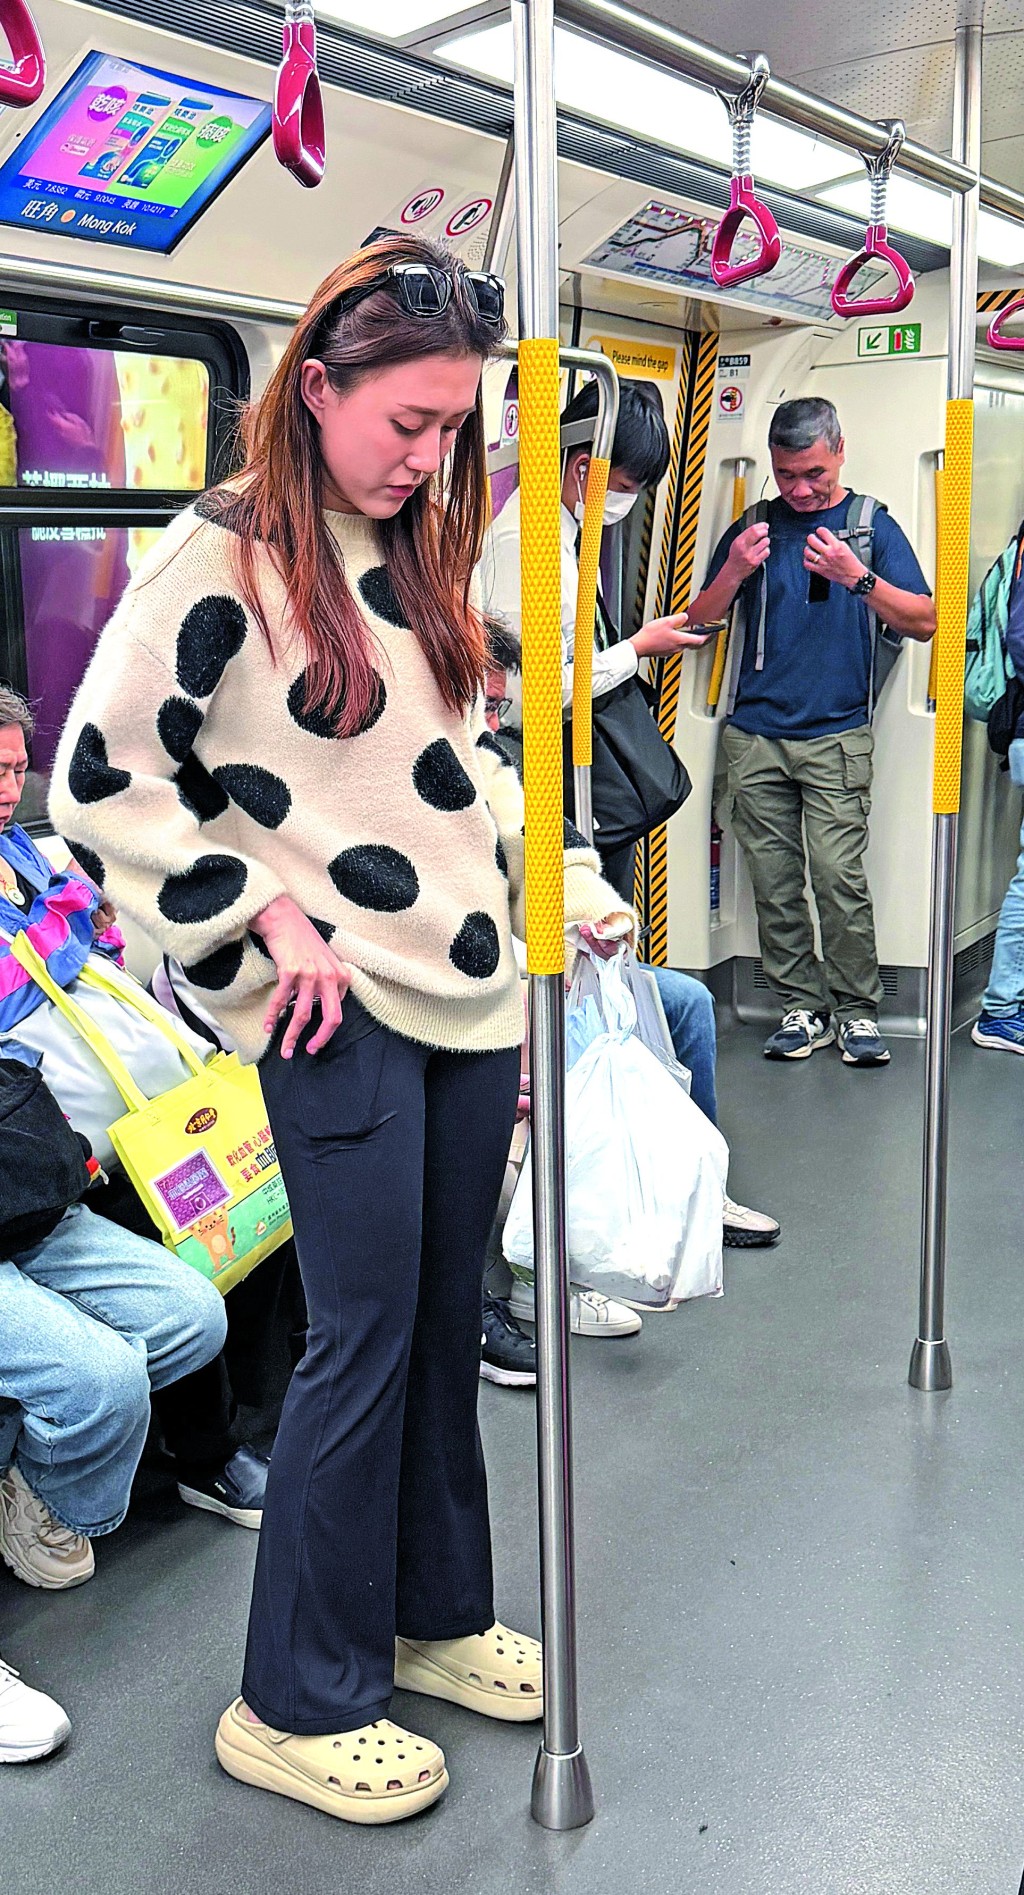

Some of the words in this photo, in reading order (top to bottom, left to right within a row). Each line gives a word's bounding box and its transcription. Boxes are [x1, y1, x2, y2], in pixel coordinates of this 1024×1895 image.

[89, 93, 127, 115] 乾咳
[23, 179, 42, 190] 美元
[21, 199, 59, 222] 旺角
[77, 213, 113, 232] Mong
[111, 221, 137, 236] Kok
[612, 350, 631, 365] Please
[631, 354, 647, 367] mind
[647, 354, 657, 368] the
[657, 360, 668, 373] gap
